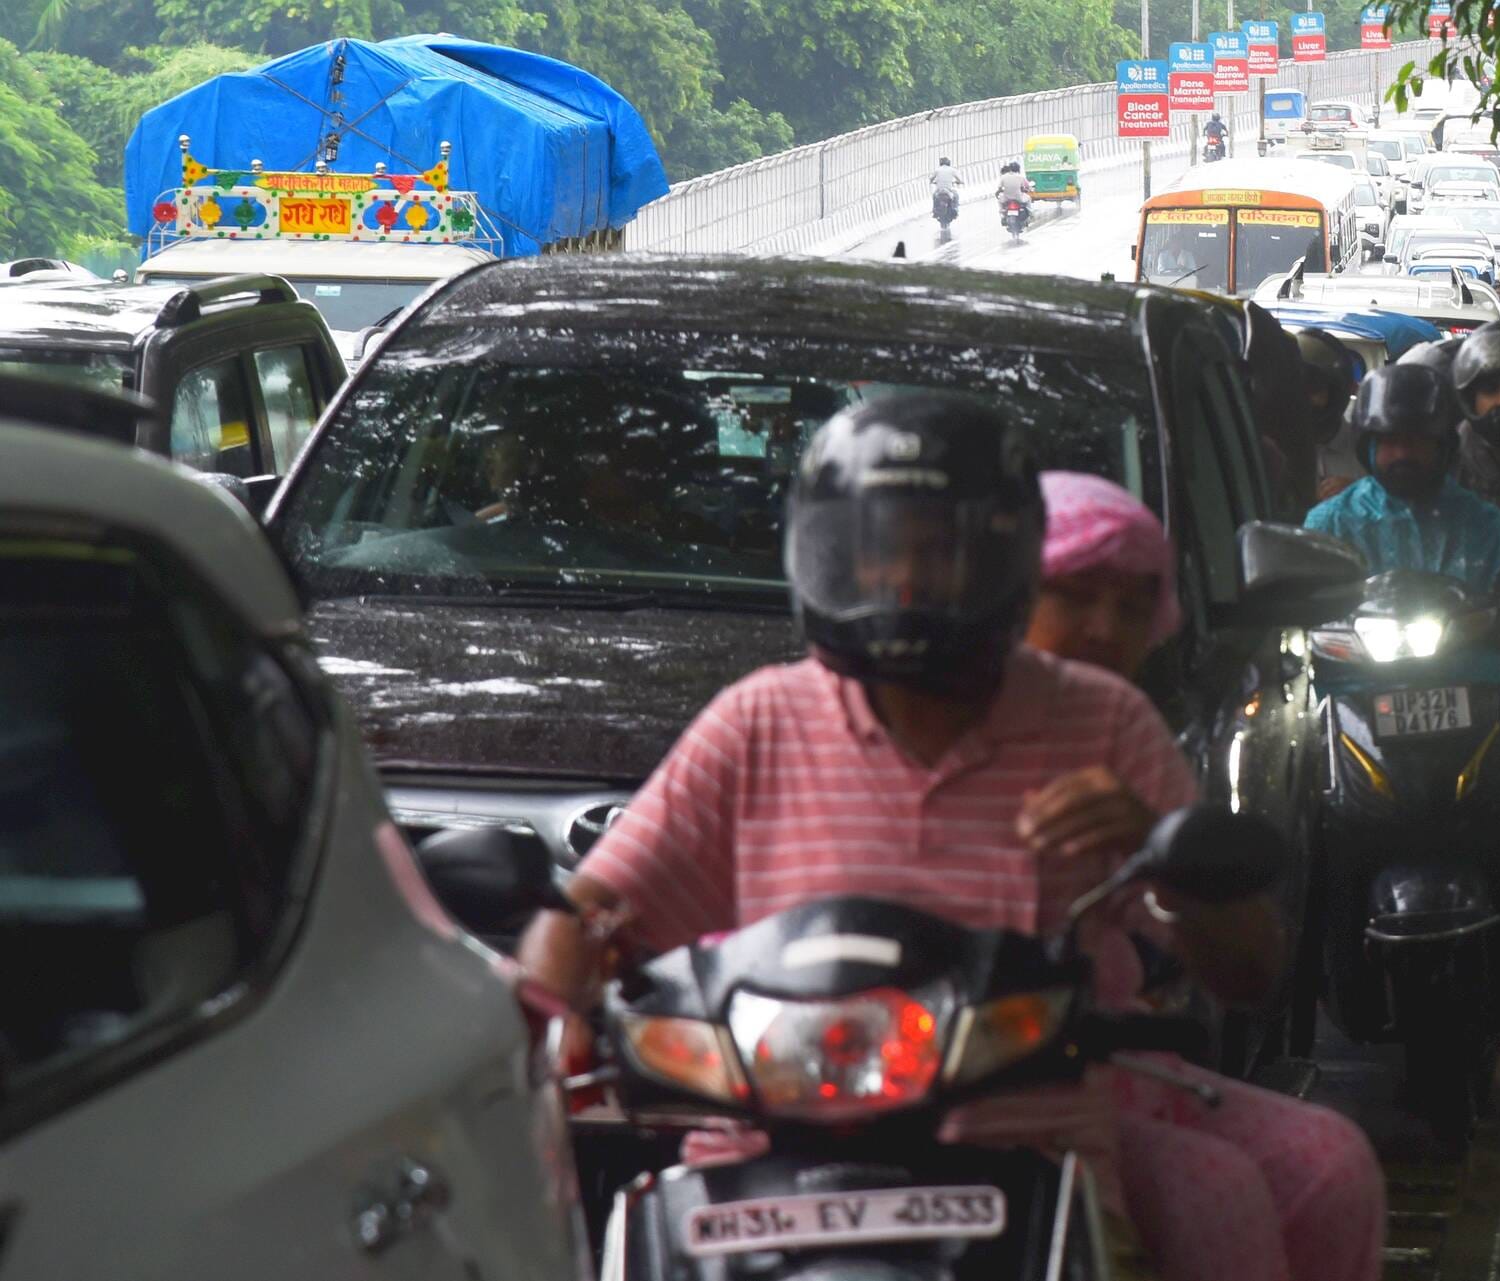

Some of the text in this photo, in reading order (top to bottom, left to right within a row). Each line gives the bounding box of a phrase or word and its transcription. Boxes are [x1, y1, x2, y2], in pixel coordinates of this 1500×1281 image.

[1217, 64, 1239, 72] Bone
[1120, 82, 1165, 91] Apollomedics
[1180, 79, 1204, 87] Bone
[1173, 87, 1210, 95] Marrow
[1170, 95, 1213, 104] Transplant
[1127, 102, 1159, 111] Blood
[1123, 111, 1164, 120] Cancer
[1119, 120, 1168, 129] Treatment
[283, 199, 348, 226] राधे राधे
[817, 1198, 867, 1231] EV
